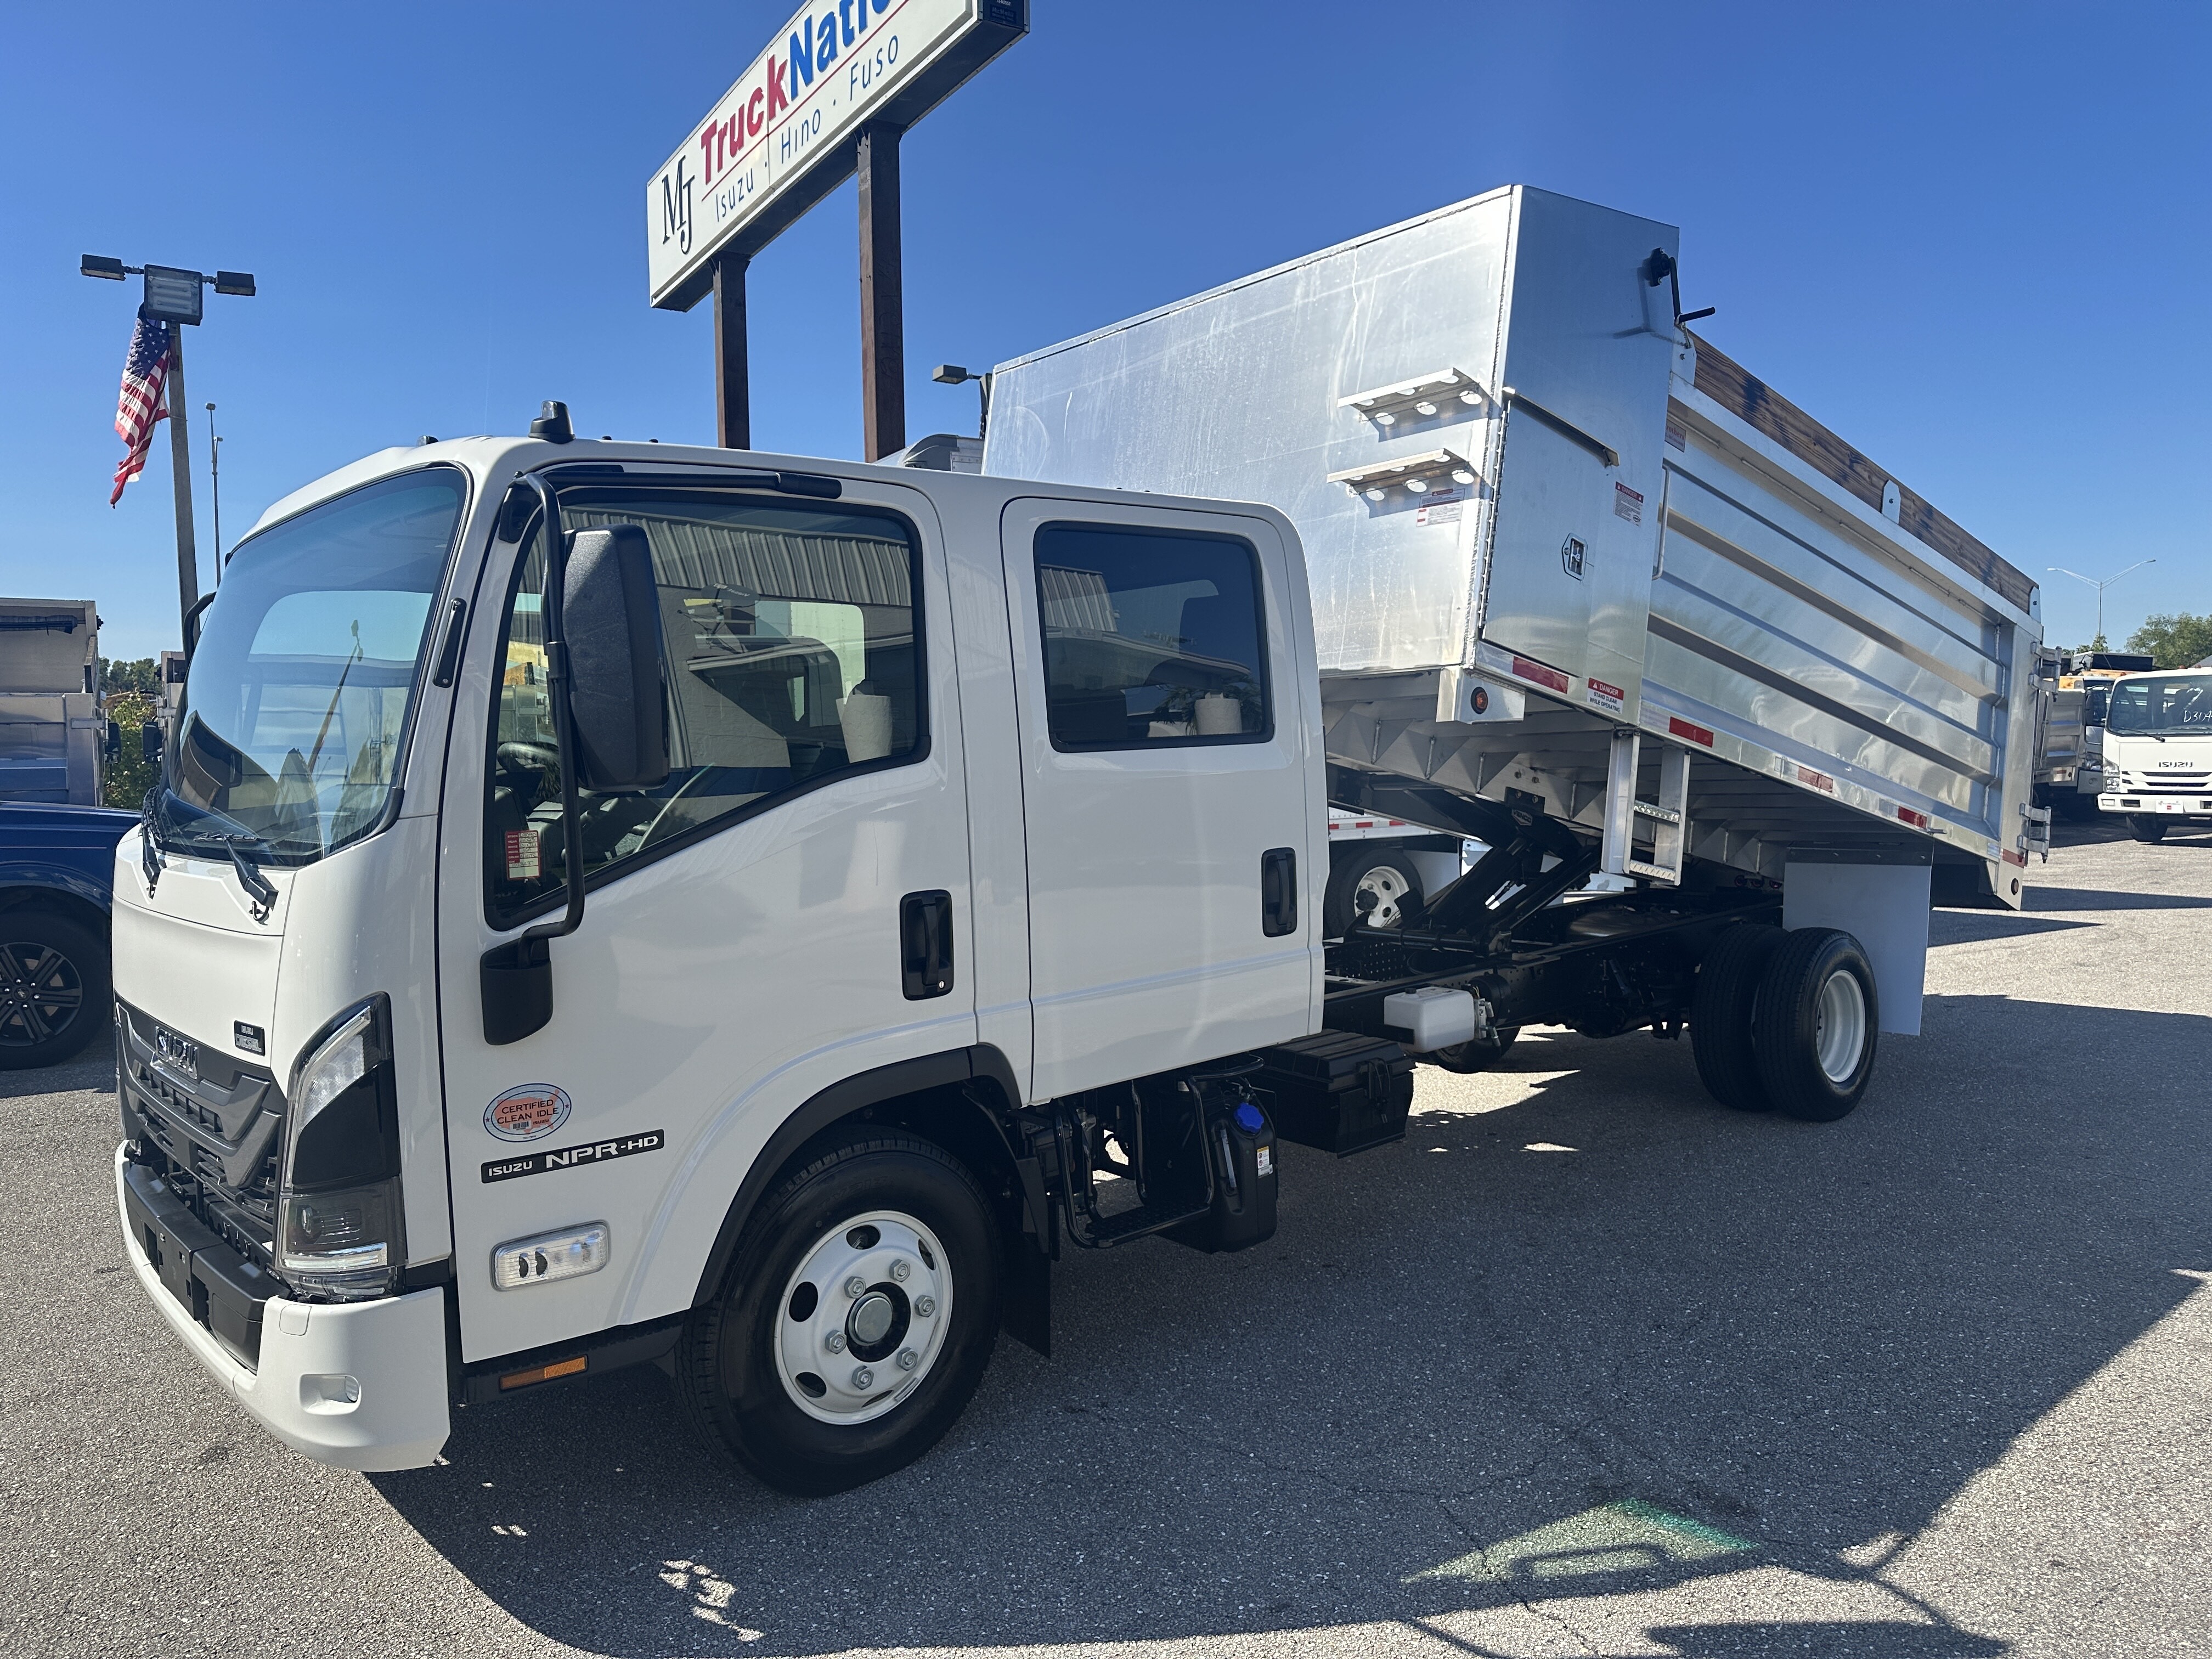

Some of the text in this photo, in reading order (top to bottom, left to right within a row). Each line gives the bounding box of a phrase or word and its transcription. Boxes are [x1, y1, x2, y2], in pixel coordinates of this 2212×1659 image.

[701, 0, 892, 185] TruckNati
[716, 35, 899, 222] Isuzu Hino Fuso
[662, 155, 696, 256] MJ
[1622, 486, 1638, 499] DANGER
[1599, 684, 1618, 697] DANGER
[1589, 697, 1601, 706] WHILE
[1605, 696, 1617, 704] CLEAR
[235, 1033, 262, 1053] DIESEL
[155, 1025, 199, 1080] ISUZU
[497, 1107, 559, 1124] CLEAN IDLE
[501, 1099, 554, 1114] CERTIFIED
[488, 1136, 658, 1176] ISUZU NPR-HD
